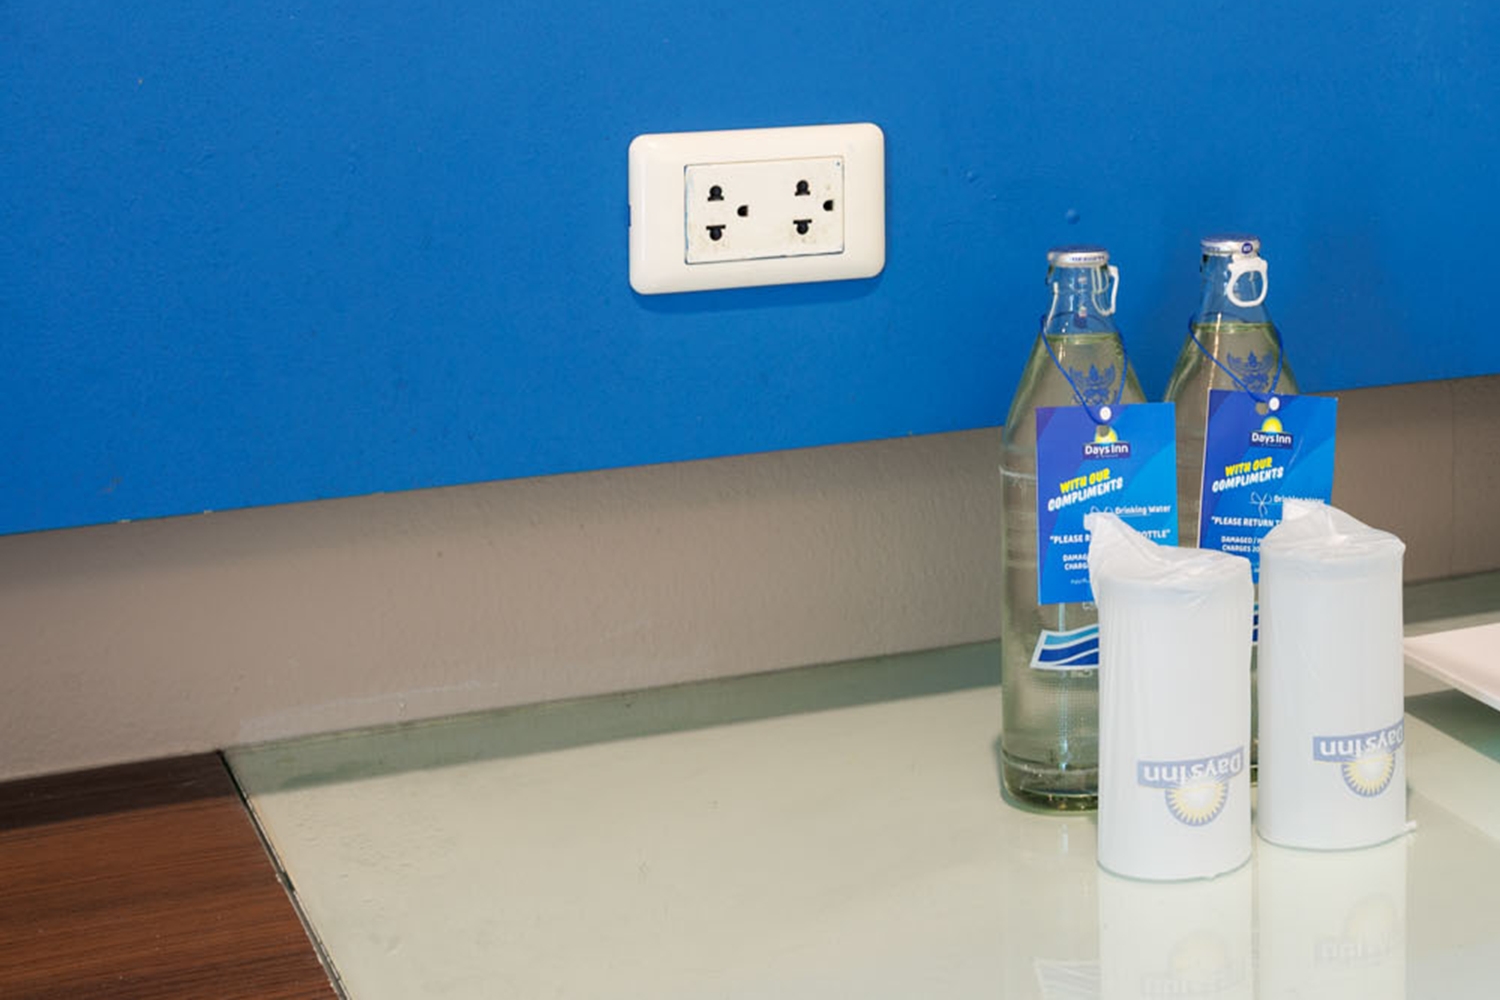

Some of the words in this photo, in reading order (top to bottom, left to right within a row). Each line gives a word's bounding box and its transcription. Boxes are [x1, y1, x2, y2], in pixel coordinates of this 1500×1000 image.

[1252, 433, 1275, 445] Days
[1276, 435, 1291, 444] Inn
[1085, 444, 1110, 456] Days
[1111, 444, 1129, 453] Inn
[1225, 461, 1251, 476] WITH
[1253, 456, 1273, 471] OUR
[1060, 477, 1087, 494] WITH
[1089, 468, 1111, 484] OUR
[1212, 466, 1284, 493] COMPLIMENTS
[1048, 476, 1123, 512] COMPLIMENTS
[1115, 506, 1147, 516] Drinking
[1148, 505, 1171, 513] Water
[1211, 516, 1242, 526] "PLEASE
[1243, 516, 1274, 527] RETURN
[1049, 535, 1083, 544] "PLEASE
[1222, 544, 1251, 553] CHARGES
[1062, 553, 1088, 562] DAMAG
[1064, 562, 1088, 570] CHARG
[1365, 724, 1404, 754] Days
[1320, 739, 1362, 758] Inn
[1190, 752, 1242, 778] Days
[1143, 765, 1186, 785] Inn
